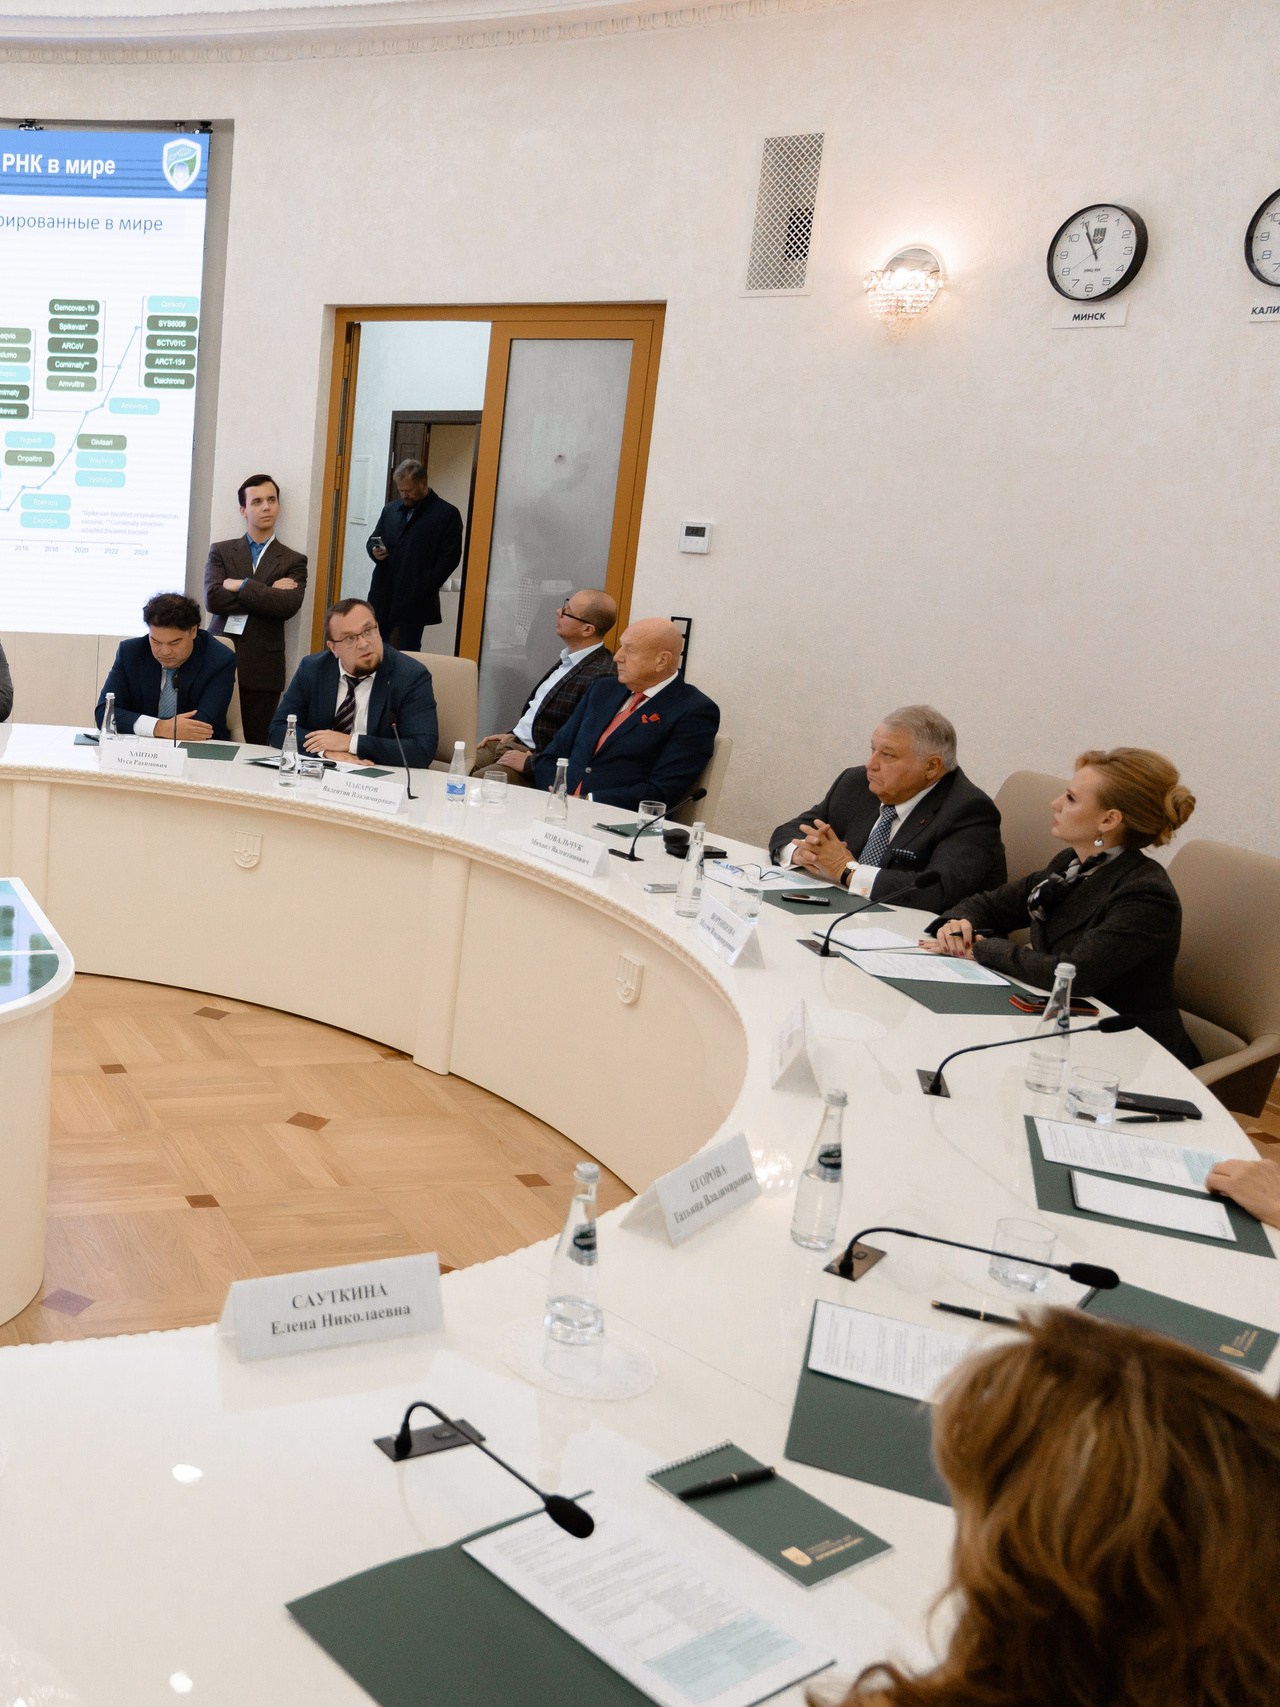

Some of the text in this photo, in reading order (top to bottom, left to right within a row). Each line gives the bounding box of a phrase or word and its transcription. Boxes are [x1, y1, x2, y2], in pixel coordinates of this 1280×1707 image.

[2, 152, 42, 174] РНК
[48, 157, 60, 174] в
[65, 158, 116, 179] мире
[1096, 213, 1109, 223] 12
[1115, 218, 1120, 227] 1
[105, 217, 114, 231] в
[119, 217, 163, 235] мире
[1067, 234, 1080, 242] 10
[1121, 229, 1132, 239] 2
[1260, 231, 1270, 242] 9
[1060, 251, 1069, 260] 9
[1123, 246, 1133, 255] 3
[1261, 249, 1272, 260] 8
[1061, 267, 1071, 276] 8
[1115, 264, 1124, 272] 4
[1071, 278, 1080, 288] 7
[1102, 277, 1112, 286] 5
[1084, 284, 1094, 293] 6
[1072, 312, 1106, 322] МИНСК
[117, 757, 132, 765] Муса
[345, 781, 379, 793] МАКАРОВ
[543, 832, 584, 852] КОВАЛЬЧУК
[689, 1164, 728, 1193] ЕГОРОВА
[673, 1171, 753, 1225] Татьяна Владимировна
[291, 1282, 389, 1310] САУТКИНА
[271, 1303, 412, 1336] Елена Николаевна
